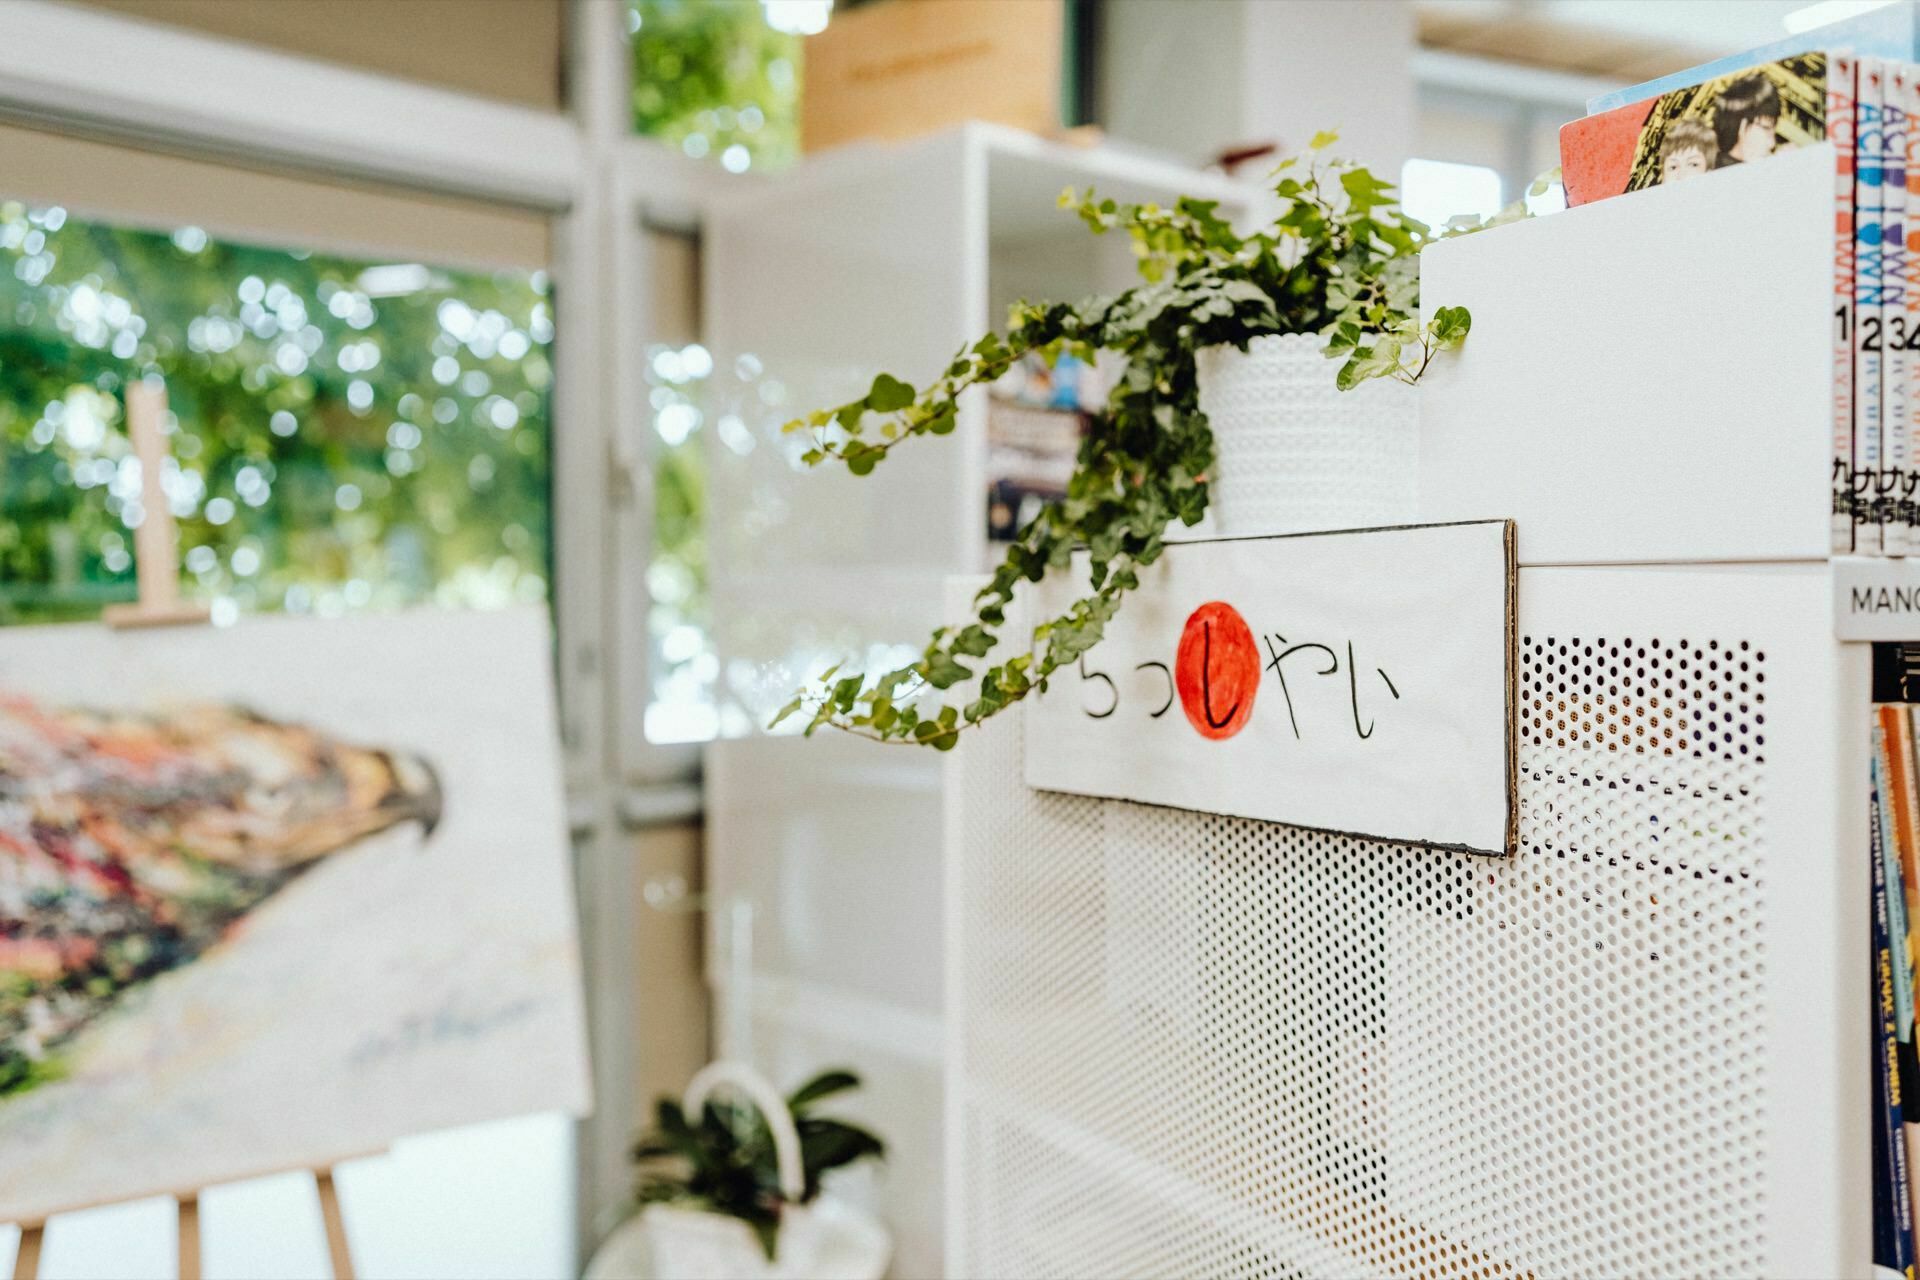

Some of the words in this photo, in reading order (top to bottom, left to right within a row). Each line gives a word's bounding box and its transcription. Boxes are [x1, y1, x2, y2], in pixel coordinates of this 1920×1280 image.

[1835, 305, 1847, 341] 1
[1861, 316, 1883, 351] 2
[1889, 316, 1906, 351] 3
